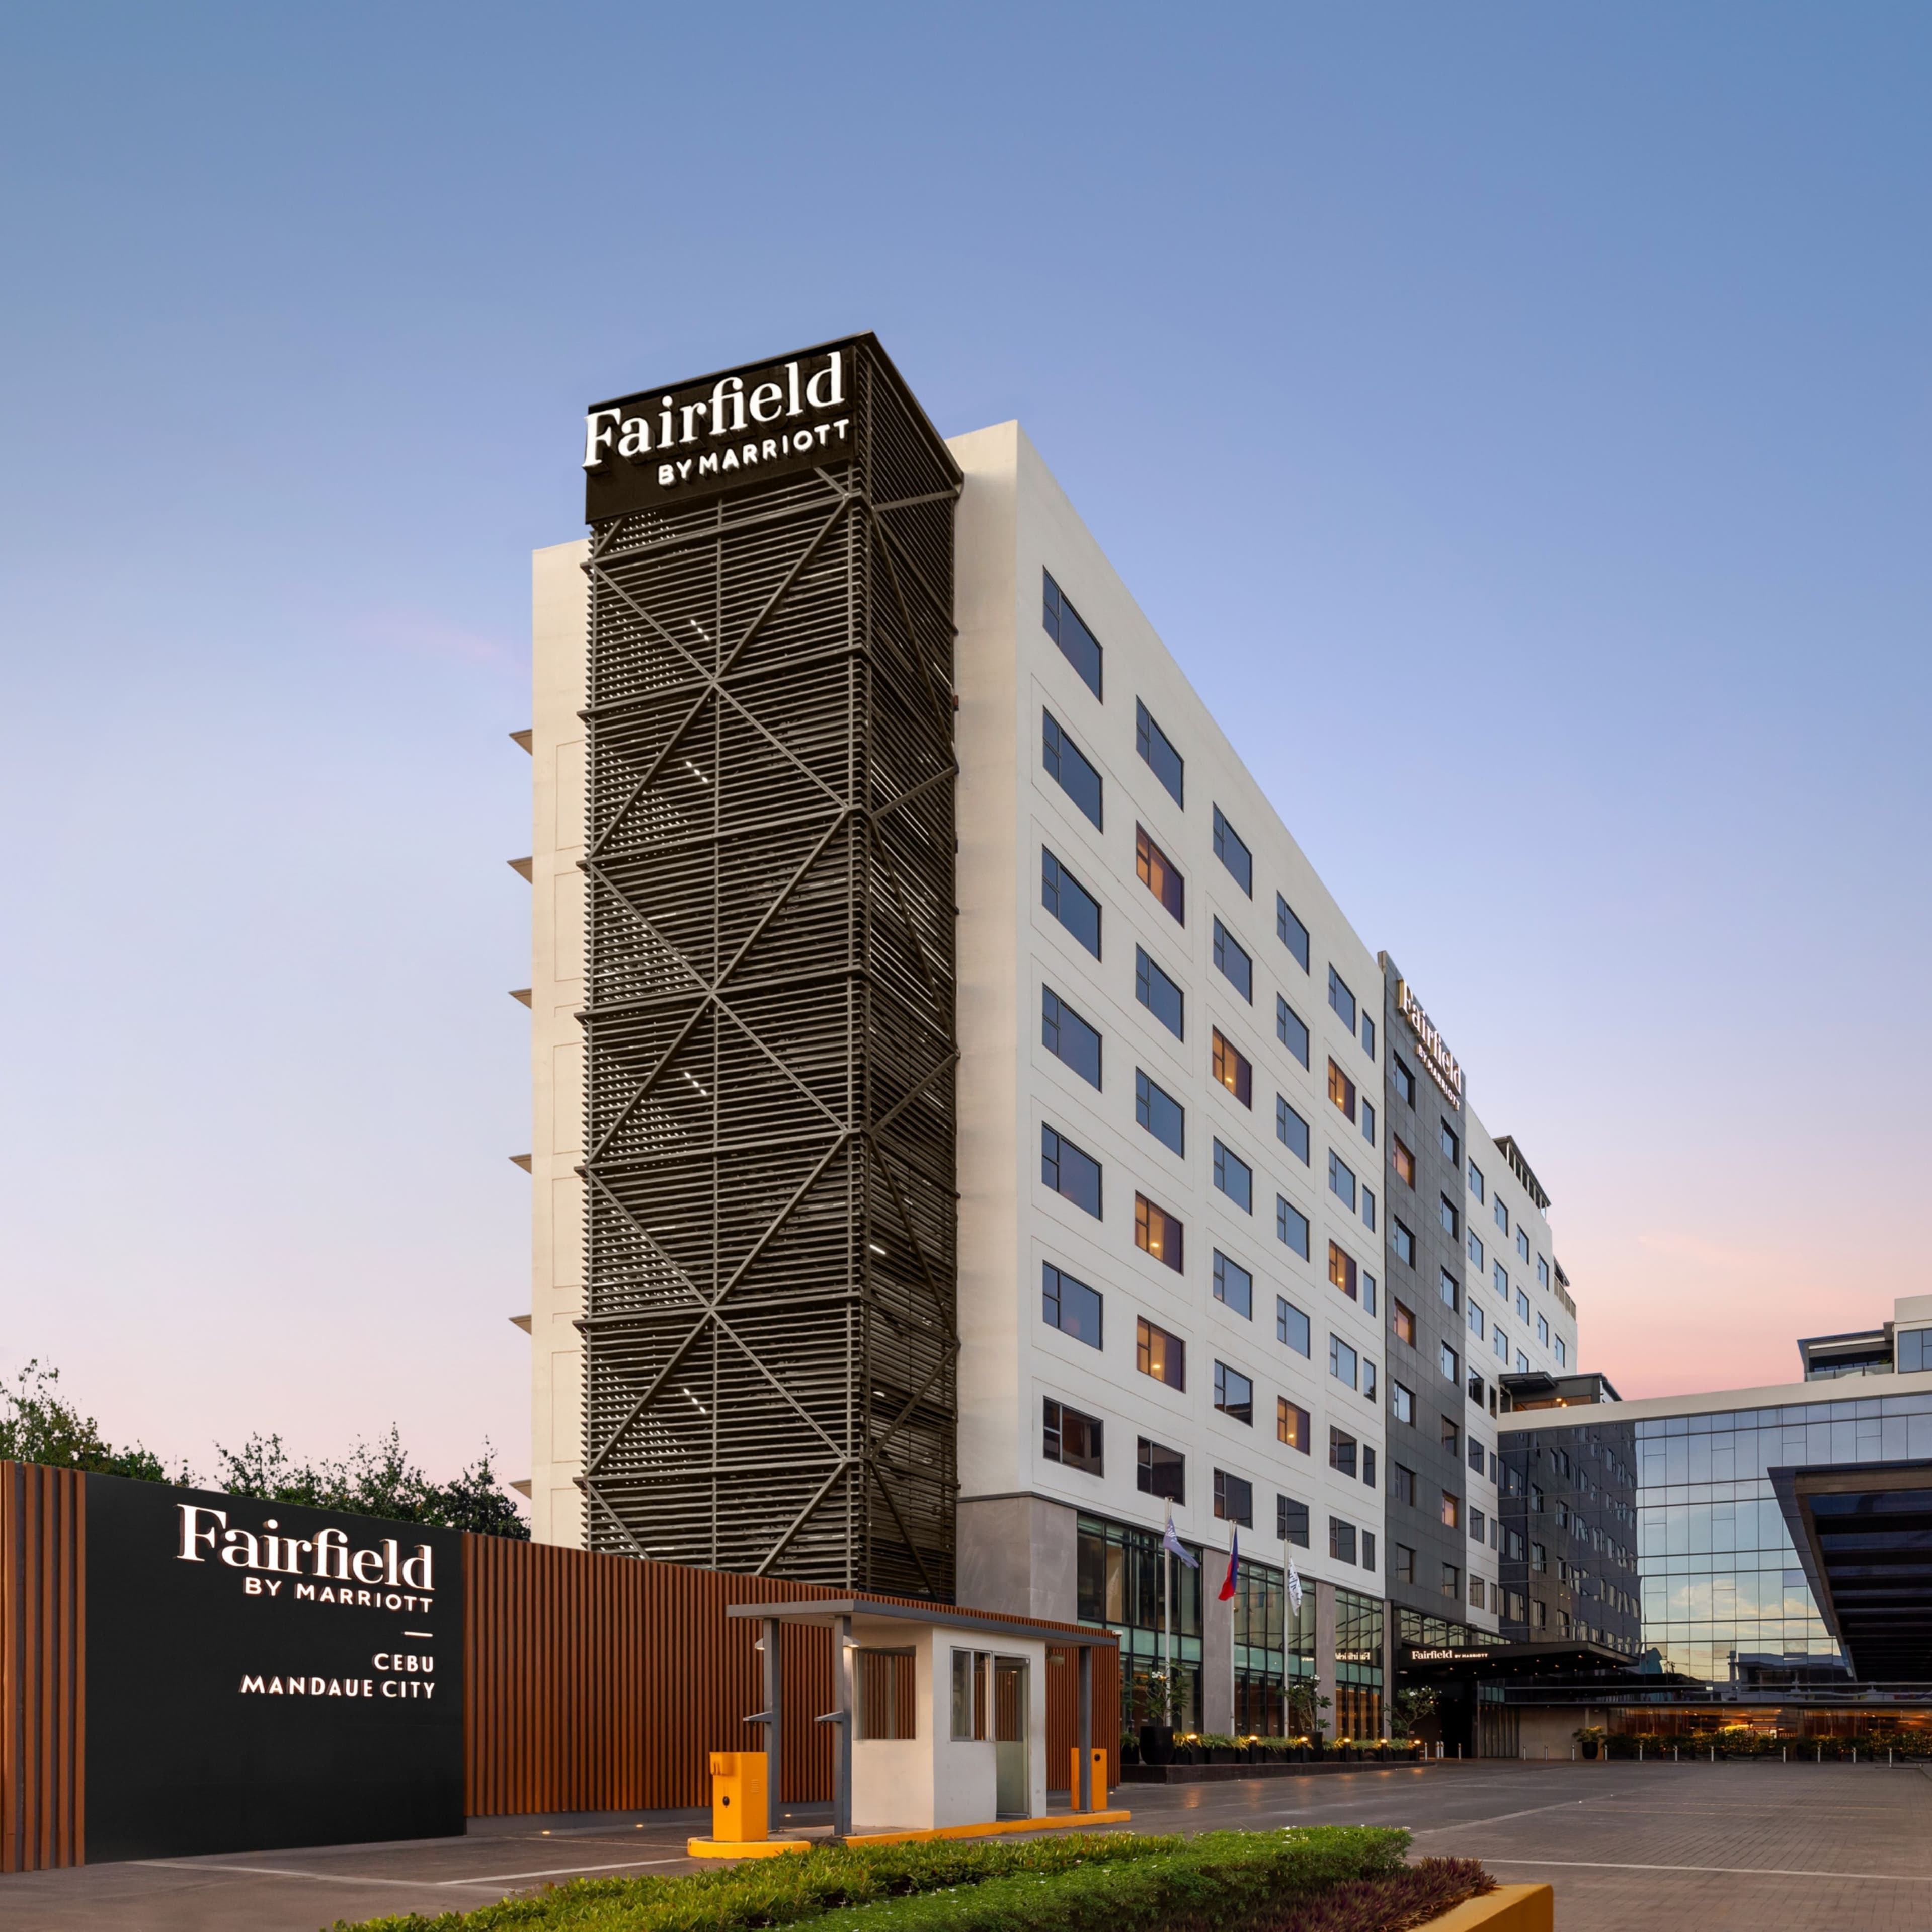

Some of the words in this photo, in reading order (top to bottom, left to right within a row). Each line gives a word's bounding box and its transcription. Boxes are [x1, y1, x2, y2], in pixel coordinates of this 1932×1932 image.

[582, 351, 845, 469] Fairfield
[658, 459, 693, 487] BY
[699, 419, 850, 476] MARRIOTT
[1397, 978, 1462, 1095] Fairfield
[1416, 1043, 1428, 1064] BY
[1424, 1062, 1460, 1111] MARRIOTT
[175, 1503, 435, 1591] Fairfield
[244, 1576, 282, 1596] BY
[295, 1583, 433, 1613] MARRIOTT
[239, 1674, 373, 1697] MANDAUE
[380, 1680, 435, 1699] CITY
[372, 1653, 434, 1673] CEBU
[1412, 1650, 1452, 1659] Fairfield
